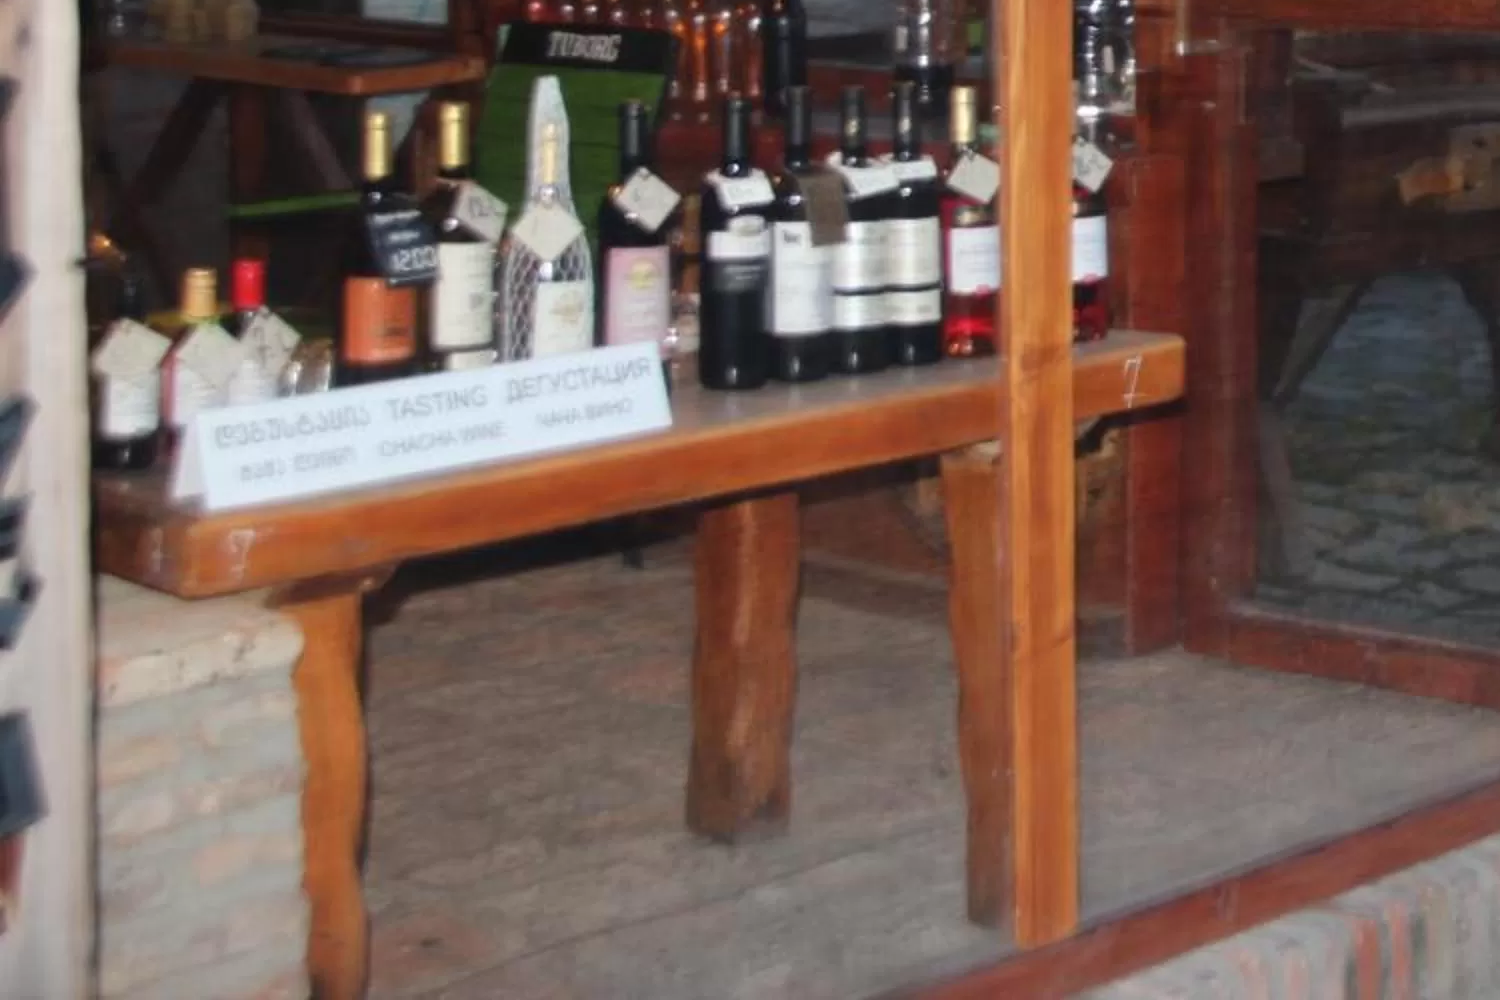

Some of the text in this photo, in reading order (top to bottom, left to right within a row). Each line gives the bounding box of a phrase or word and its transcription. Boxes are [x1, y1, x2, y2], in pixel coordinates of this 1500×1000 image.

[214, 356, 652, 450] დეგუსტაცია TASTING ДЕГУСТАЦИЯ
